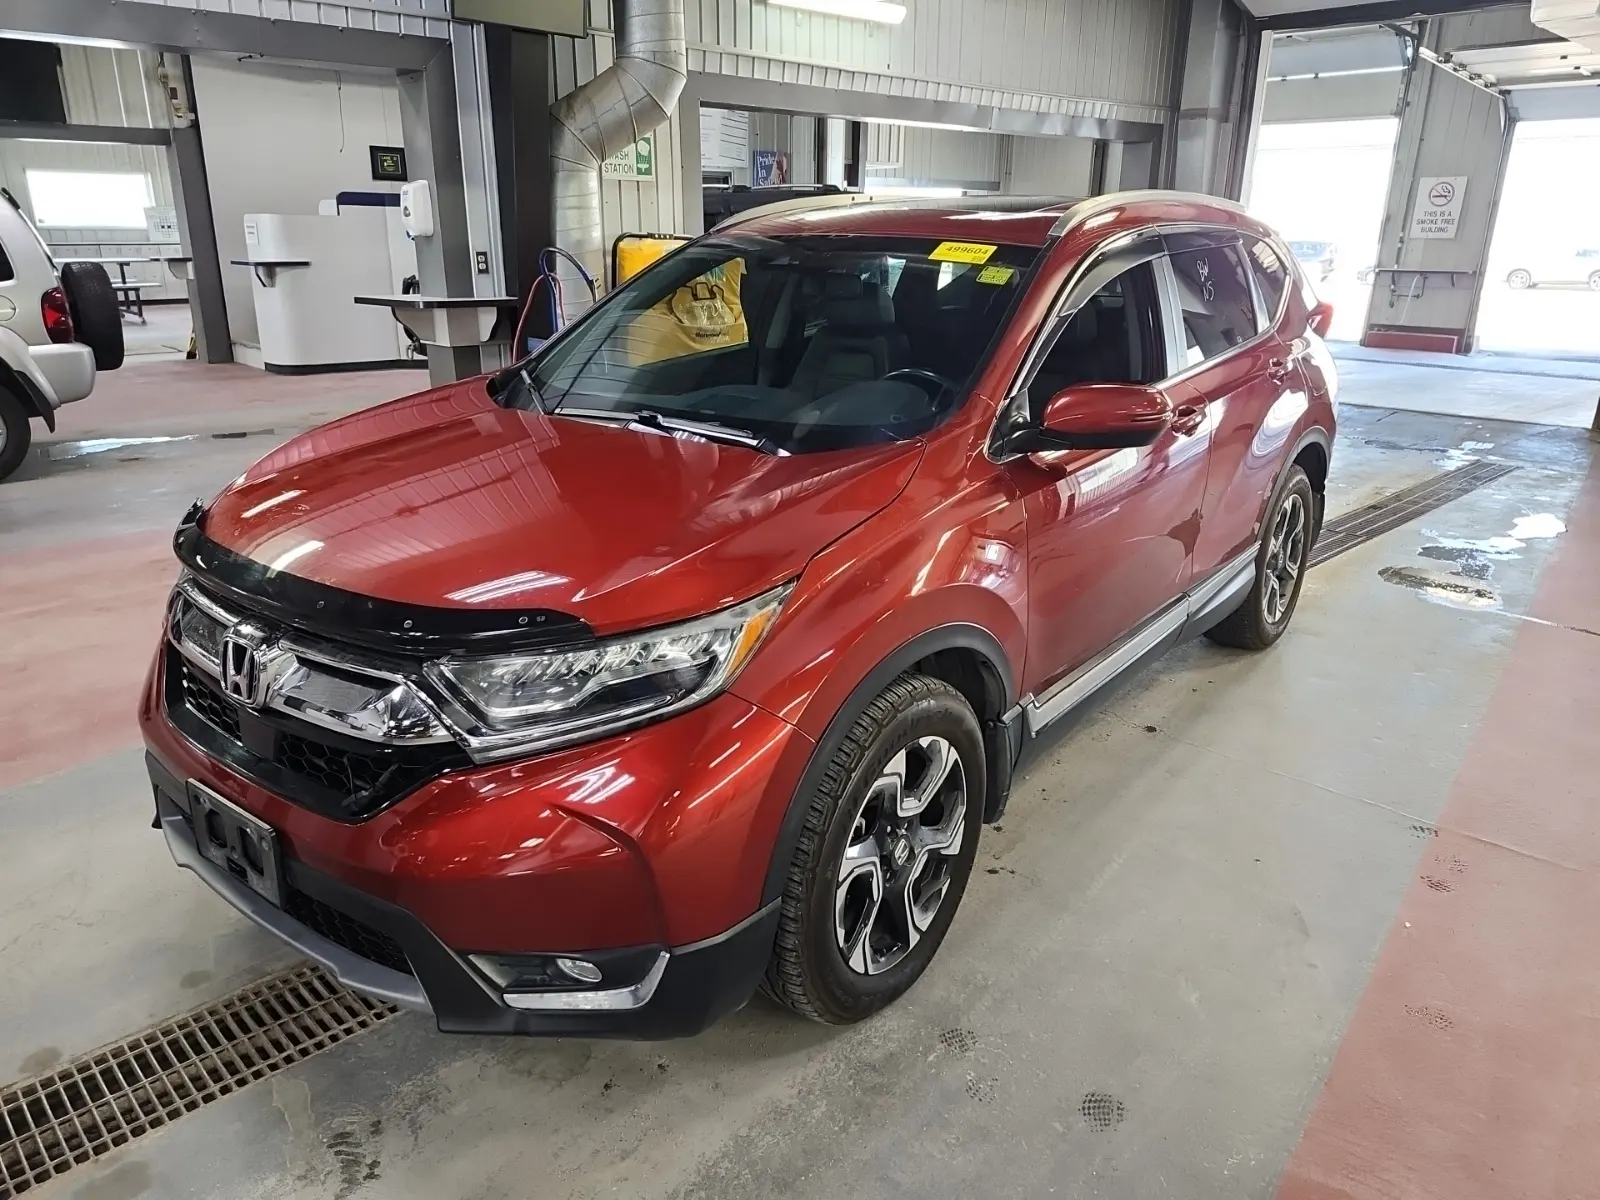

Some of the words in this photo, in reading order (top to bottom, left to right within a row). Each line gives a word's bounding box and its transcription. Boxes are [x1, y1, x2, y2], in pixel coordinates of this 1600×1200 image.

[757, 153, 775, 167] Pride
[604, 163, 634, 174] STATION
[758, 167, 767, 177] In
[945, 245, 989, 255] 499604
